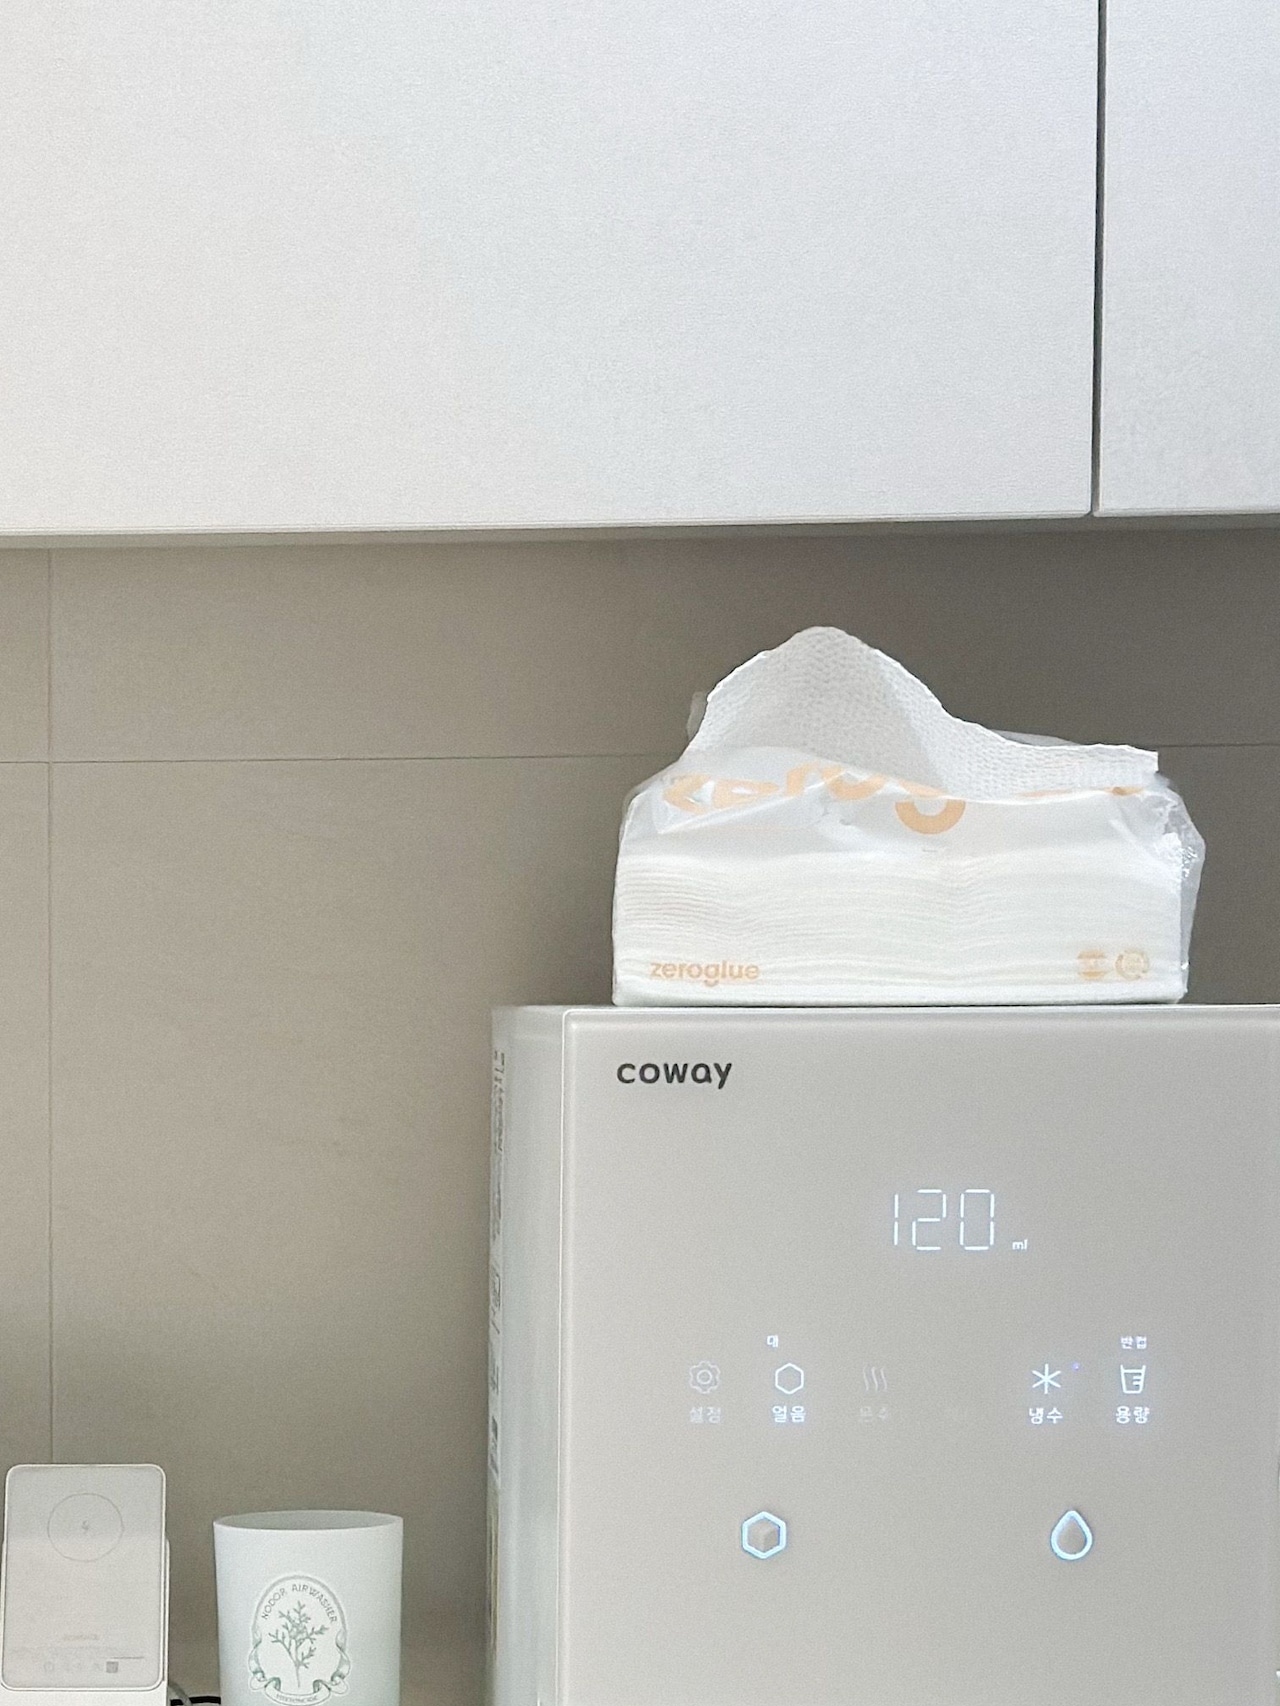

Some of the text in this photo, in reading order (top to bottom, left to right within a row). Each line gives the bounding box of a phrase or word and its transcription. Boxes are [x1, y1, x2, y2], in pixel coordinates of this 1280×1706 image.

[650, 961, 761, 986] zeroglue
[616, 1059, 732, 1088] coway
[893, 1188, 1028, 1251] 120 ml
[689, 1405, 722, 1424] 설정
[772, 1404, 806, 1424] 얼음
[1028, 1406, 1063, 1425] 냉수
[1115, 1404, 1150, 1425] 용량
[261, 1583, 338, 1622] NODOR AIRWASHER
